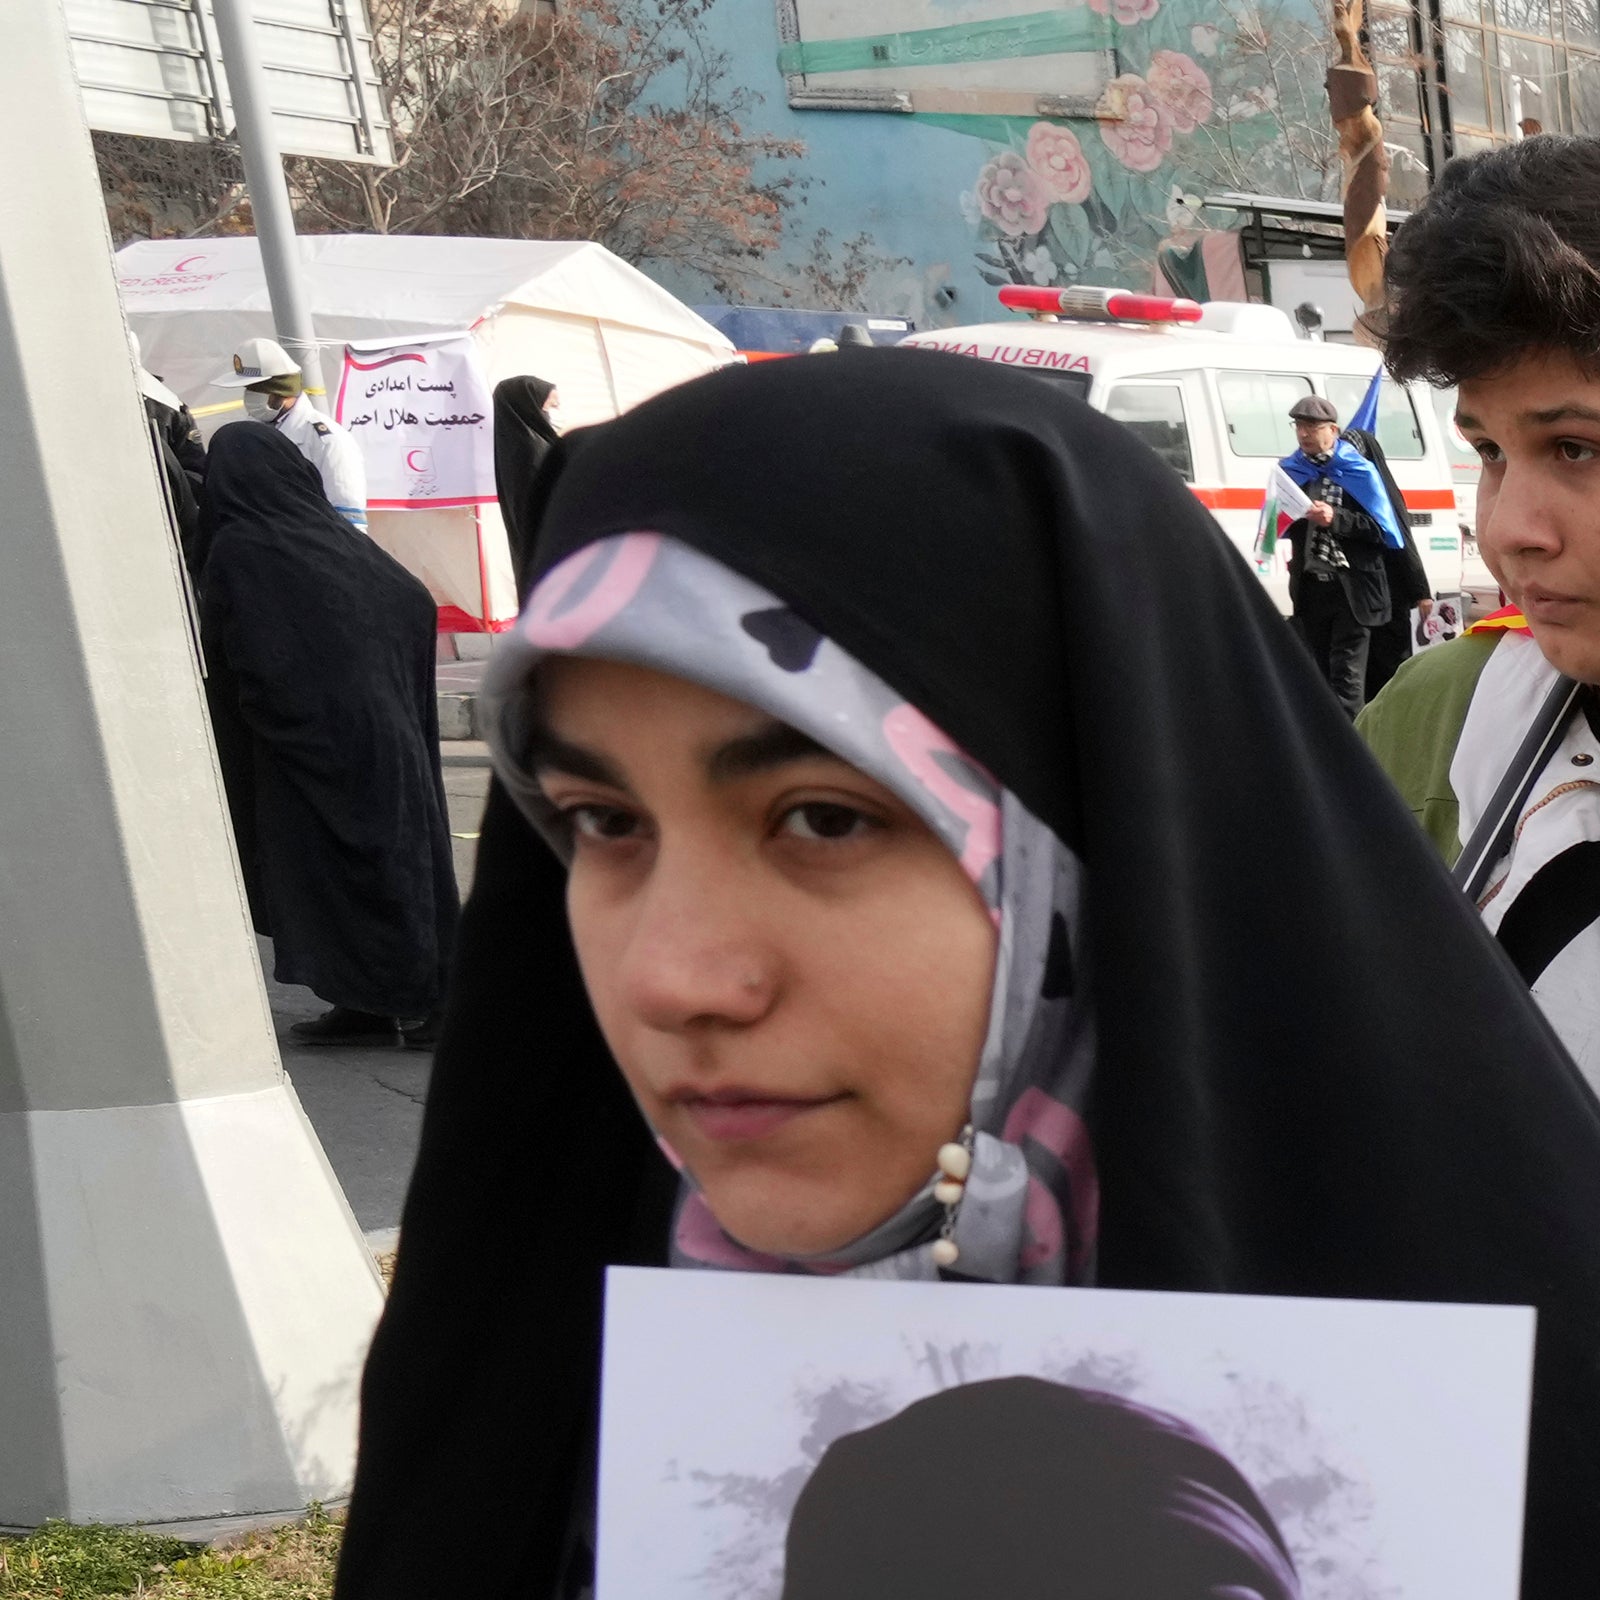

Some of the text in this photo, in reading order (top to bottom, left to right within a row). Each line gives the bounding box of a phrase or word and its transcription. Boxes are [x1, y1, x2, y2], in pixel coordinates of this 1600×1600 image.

[365, 375, 457, 399] پست امدادی
[347, 407, 486, 432] جمعیت هلال احمر
